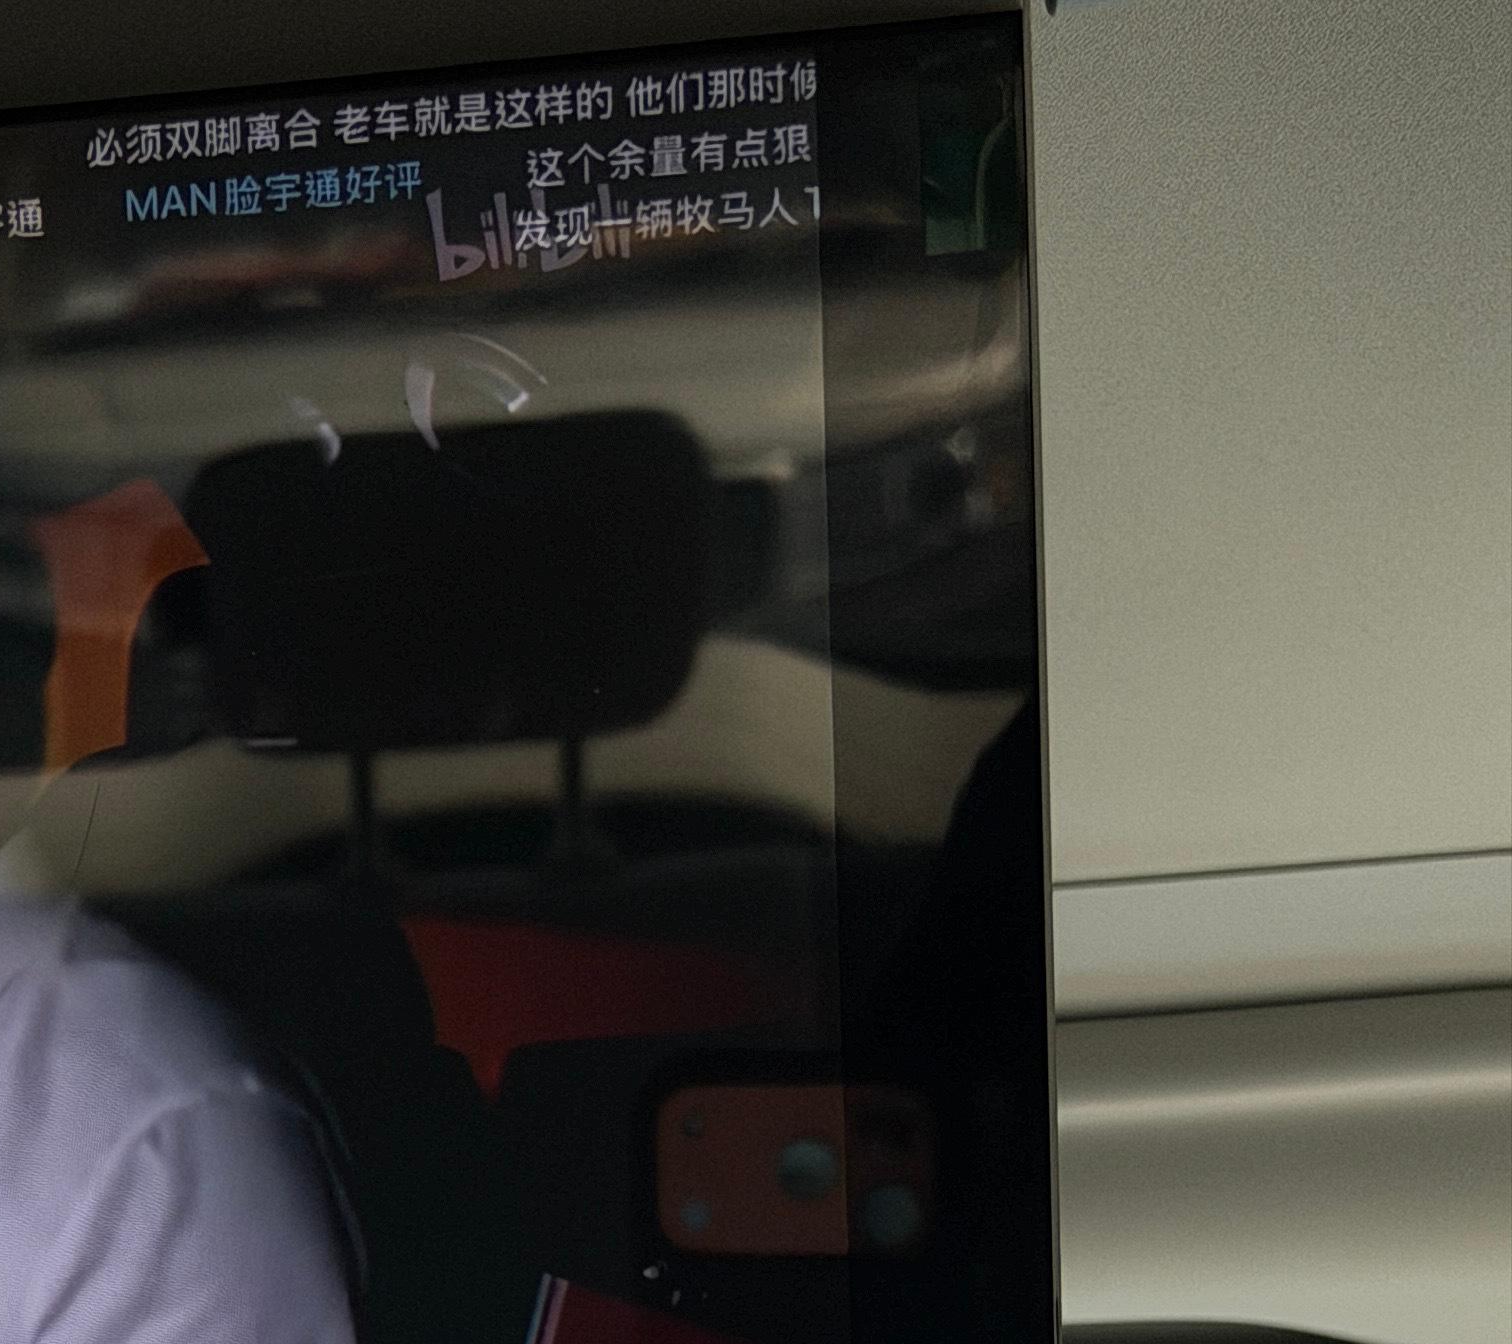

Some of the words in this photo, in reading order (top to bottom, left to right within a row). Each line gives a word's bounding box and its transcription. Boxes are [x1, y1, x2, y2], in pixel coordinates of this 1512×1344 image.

[87, 108, 321, 168] 必须双脚离合
[333, 80, 613, 144] 老车就是这样的
